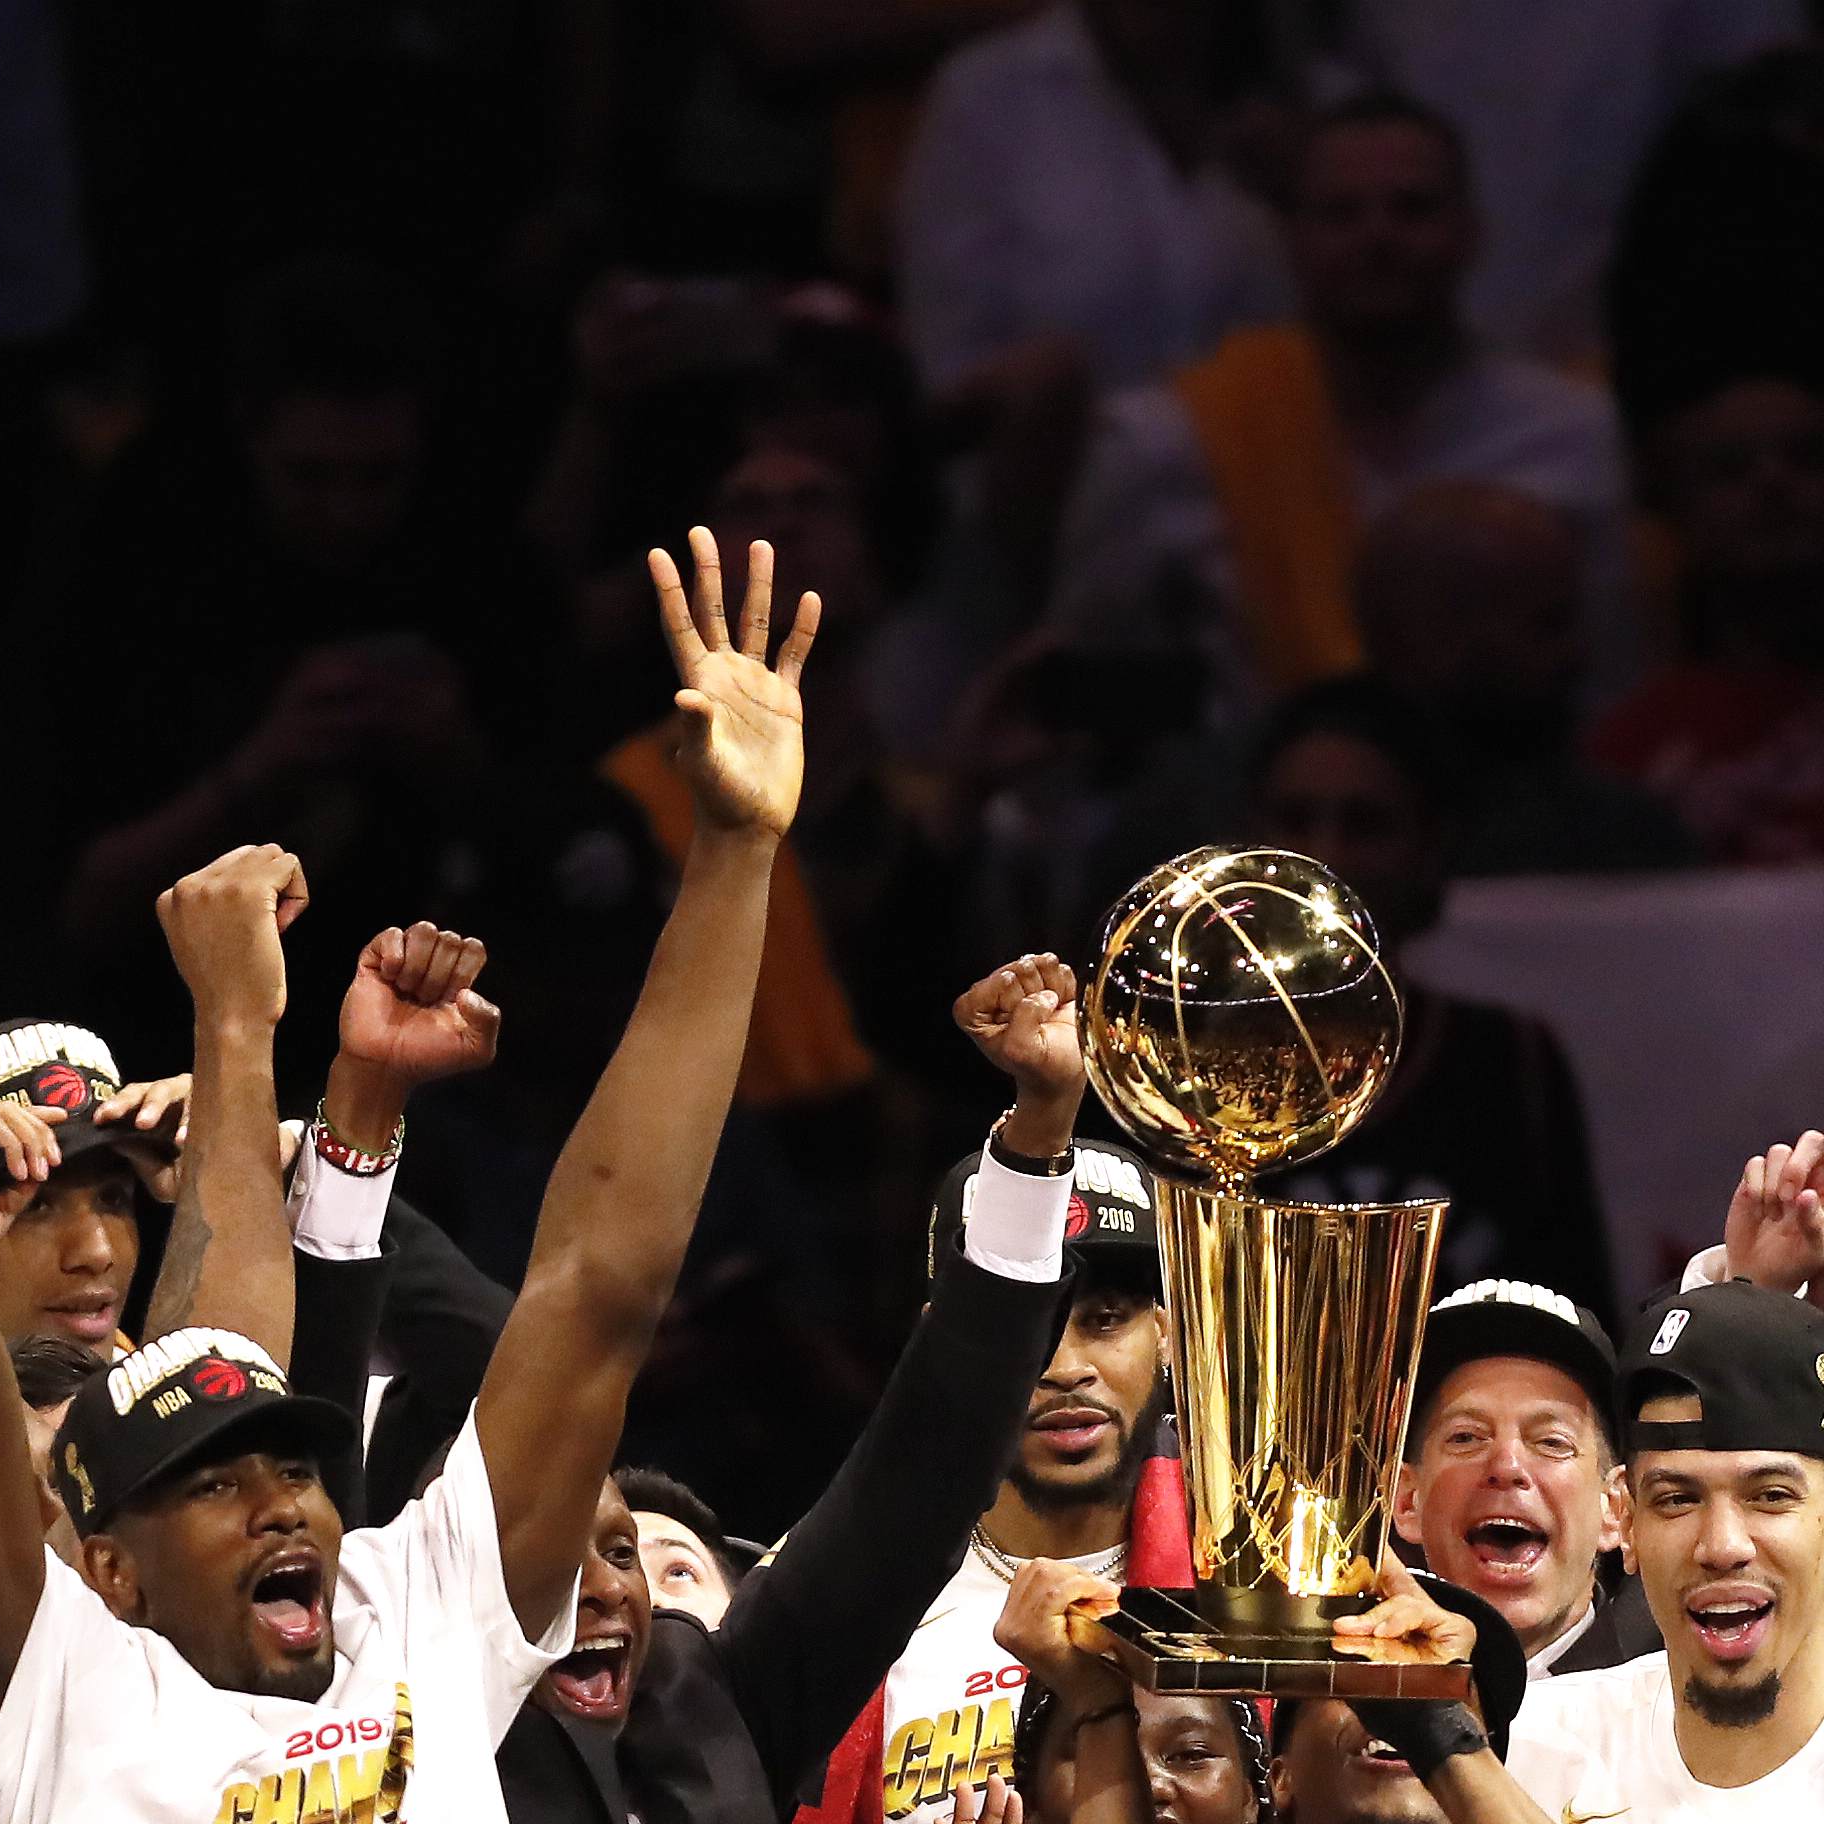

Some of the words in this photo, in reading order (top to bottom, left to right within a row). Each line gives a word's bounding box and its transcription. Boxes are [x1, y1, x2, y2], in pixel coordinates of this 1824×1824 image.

[1097, 1205, 1136, 1233] 2019
[152, 1385, 193, 1419] NBA
[285, 1717, 383, 1760] 2019
